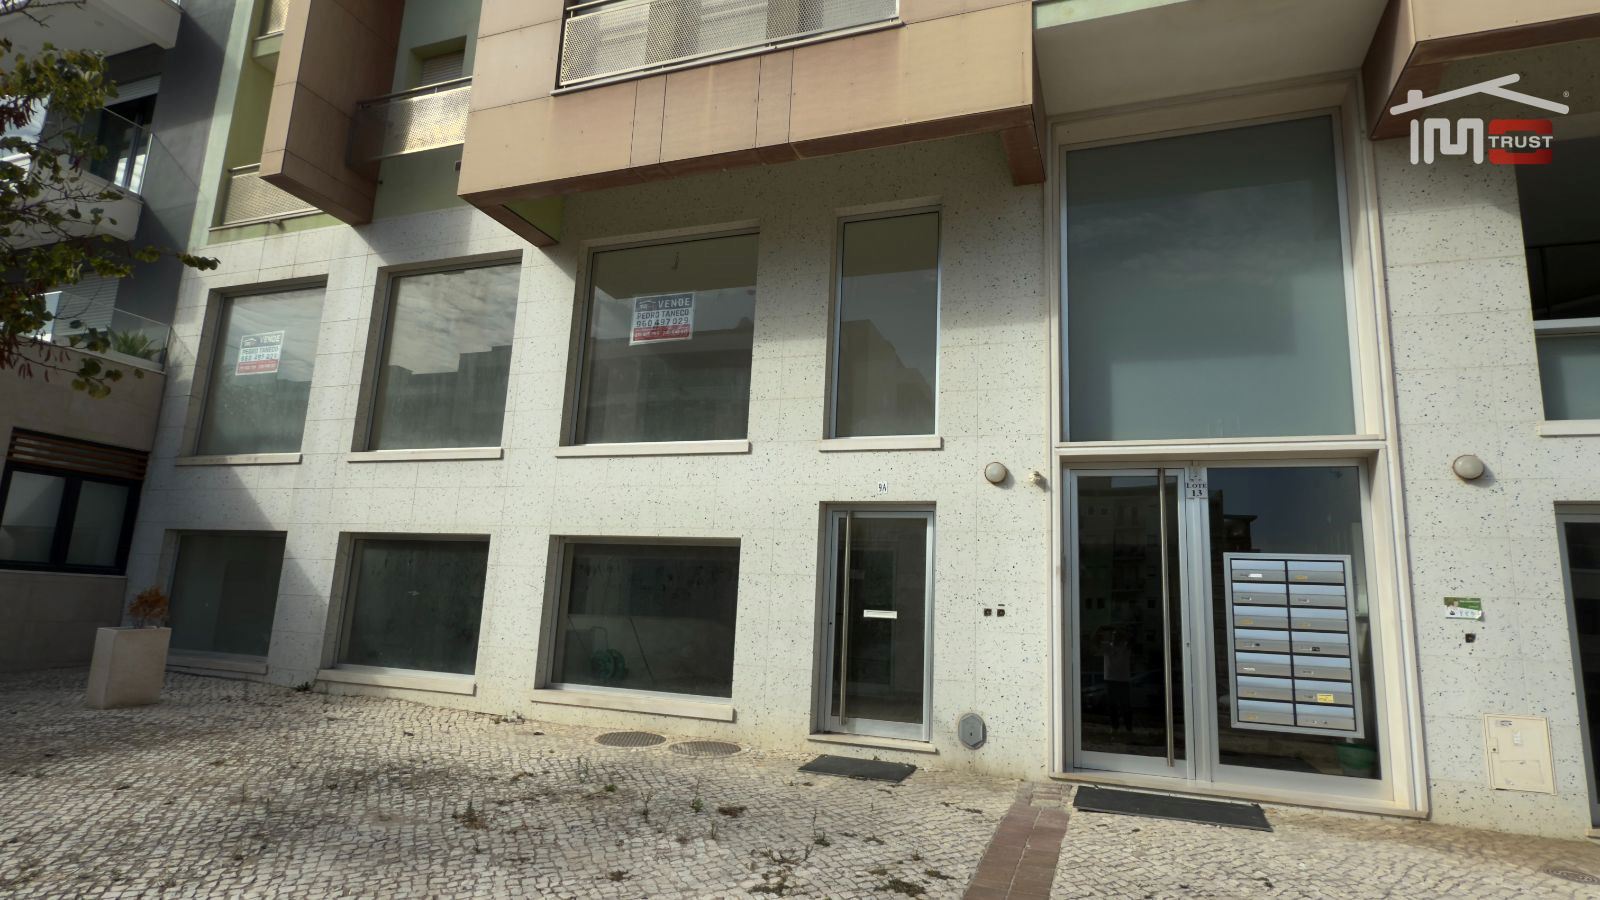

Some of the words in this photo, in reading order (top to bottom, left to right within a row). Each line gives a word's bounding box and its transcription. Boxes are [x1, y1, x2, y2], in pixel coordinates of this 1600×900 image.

[658, 297, 691, 308] VENDE
[637, 311, 660, 320] PEDRO
[1192, 489, 1203, 497] 13
